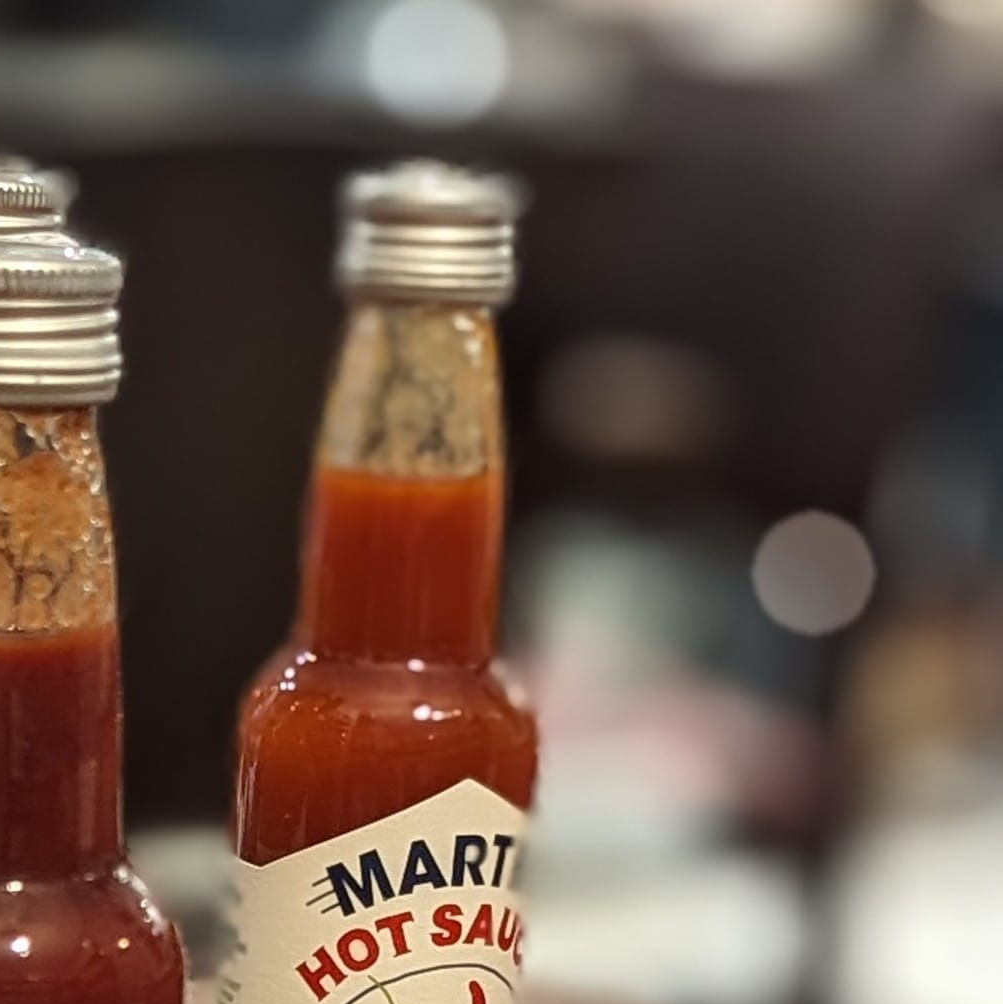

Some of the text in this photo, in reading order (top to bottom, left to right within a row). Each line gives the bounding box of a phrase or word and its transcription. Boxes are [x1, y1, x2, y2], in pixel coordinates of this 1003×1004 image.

[326, 833, 517, 917] MART
[295, 911, 415, 1002] HOT
[430, 904, 523, 966] SAUC
